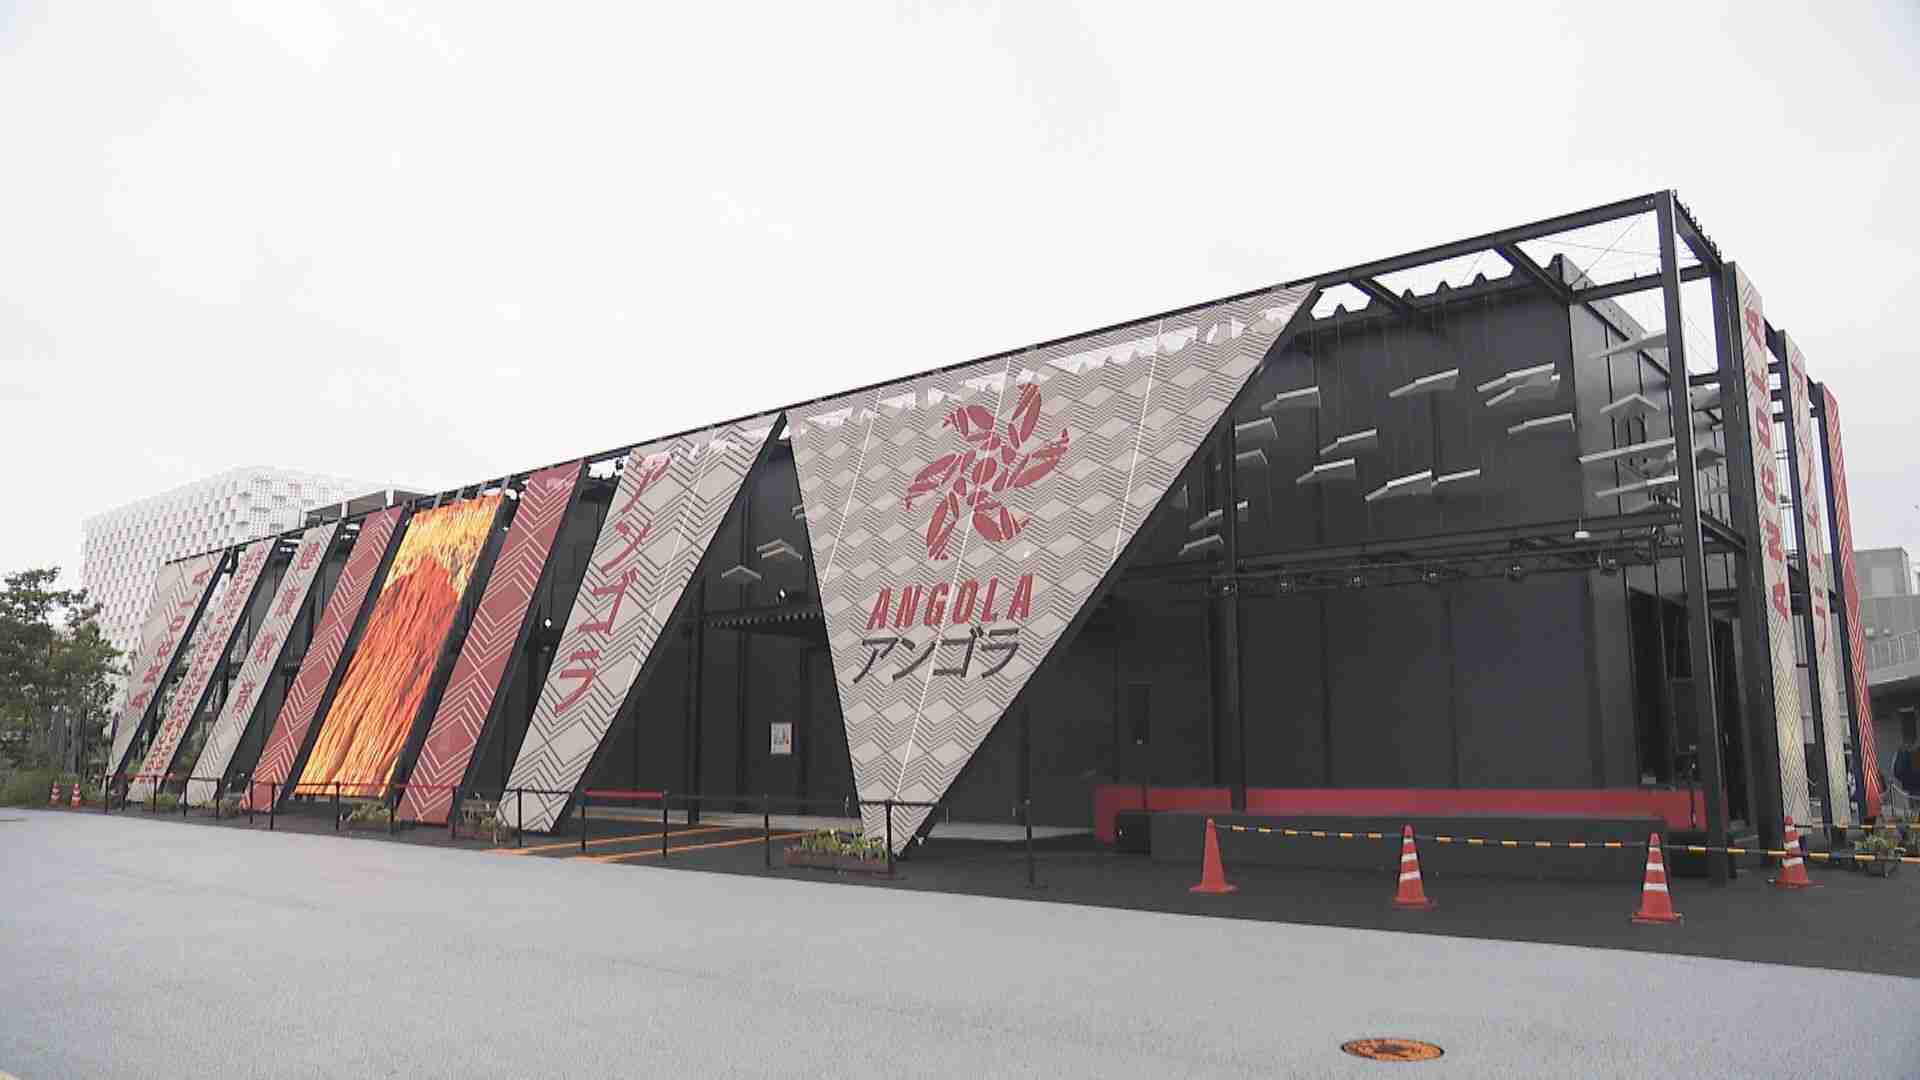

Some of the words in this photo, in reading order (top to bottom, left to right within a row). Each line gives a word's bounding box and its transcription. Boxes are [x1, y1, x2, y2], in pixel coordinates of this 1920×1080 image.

[1744, 307, 1787, 621] ANGOLA
[129, 568, 211, 708] ANGOLA
[553, 453, 671, 716] アンゴラ
[853, 626, 1022, 683] アンゴラ
[866, 574, 1037, 630] ANGOLA
